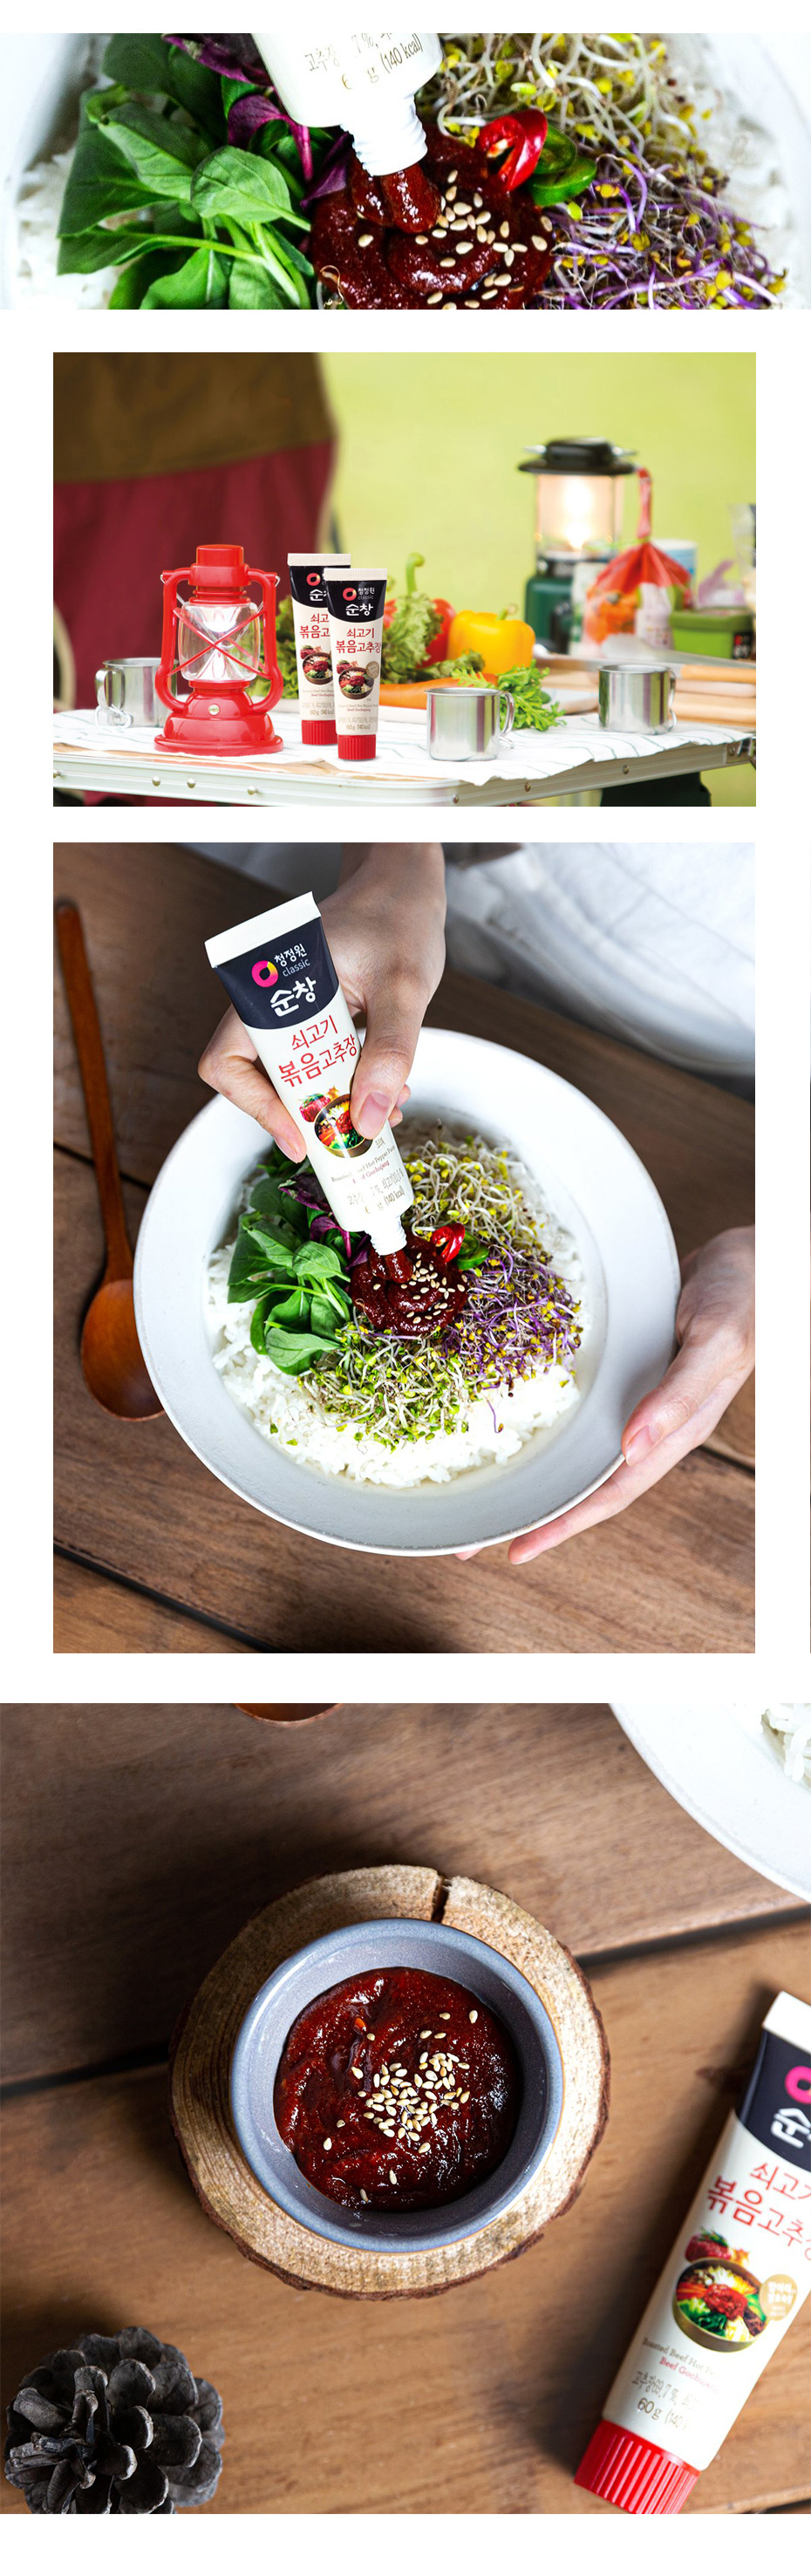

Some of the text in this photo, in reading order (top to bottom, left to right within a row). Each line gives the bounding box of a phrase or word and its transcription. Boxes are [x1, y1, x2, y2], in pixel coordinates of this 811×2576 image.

[358, 587, 375, 596] 청정원
[310, 613, 330, 624] 쇠고
[345, 603, 374, 617] 순창
[299, 624, 331, 639] 볶음고
[346, 628, 375, 638] 쇠고기
[336, 640, 381, 654] 볶음고추장
[274, 943, 307, 967] 청정원
[282, 959, 310, 978] classic
[270, 977, 317, 1018] 순창
[291, 1015, 338, 1051] 쇠고기
[278, 1034, 358, 1087] 볶음고추장
[771, 2108, 811, 2149] 순
[643, 2338, 670, 2354] Roasted
[670, 2348, 690, 2364] Beef
[659, 2357, 679, 2371] Beef
